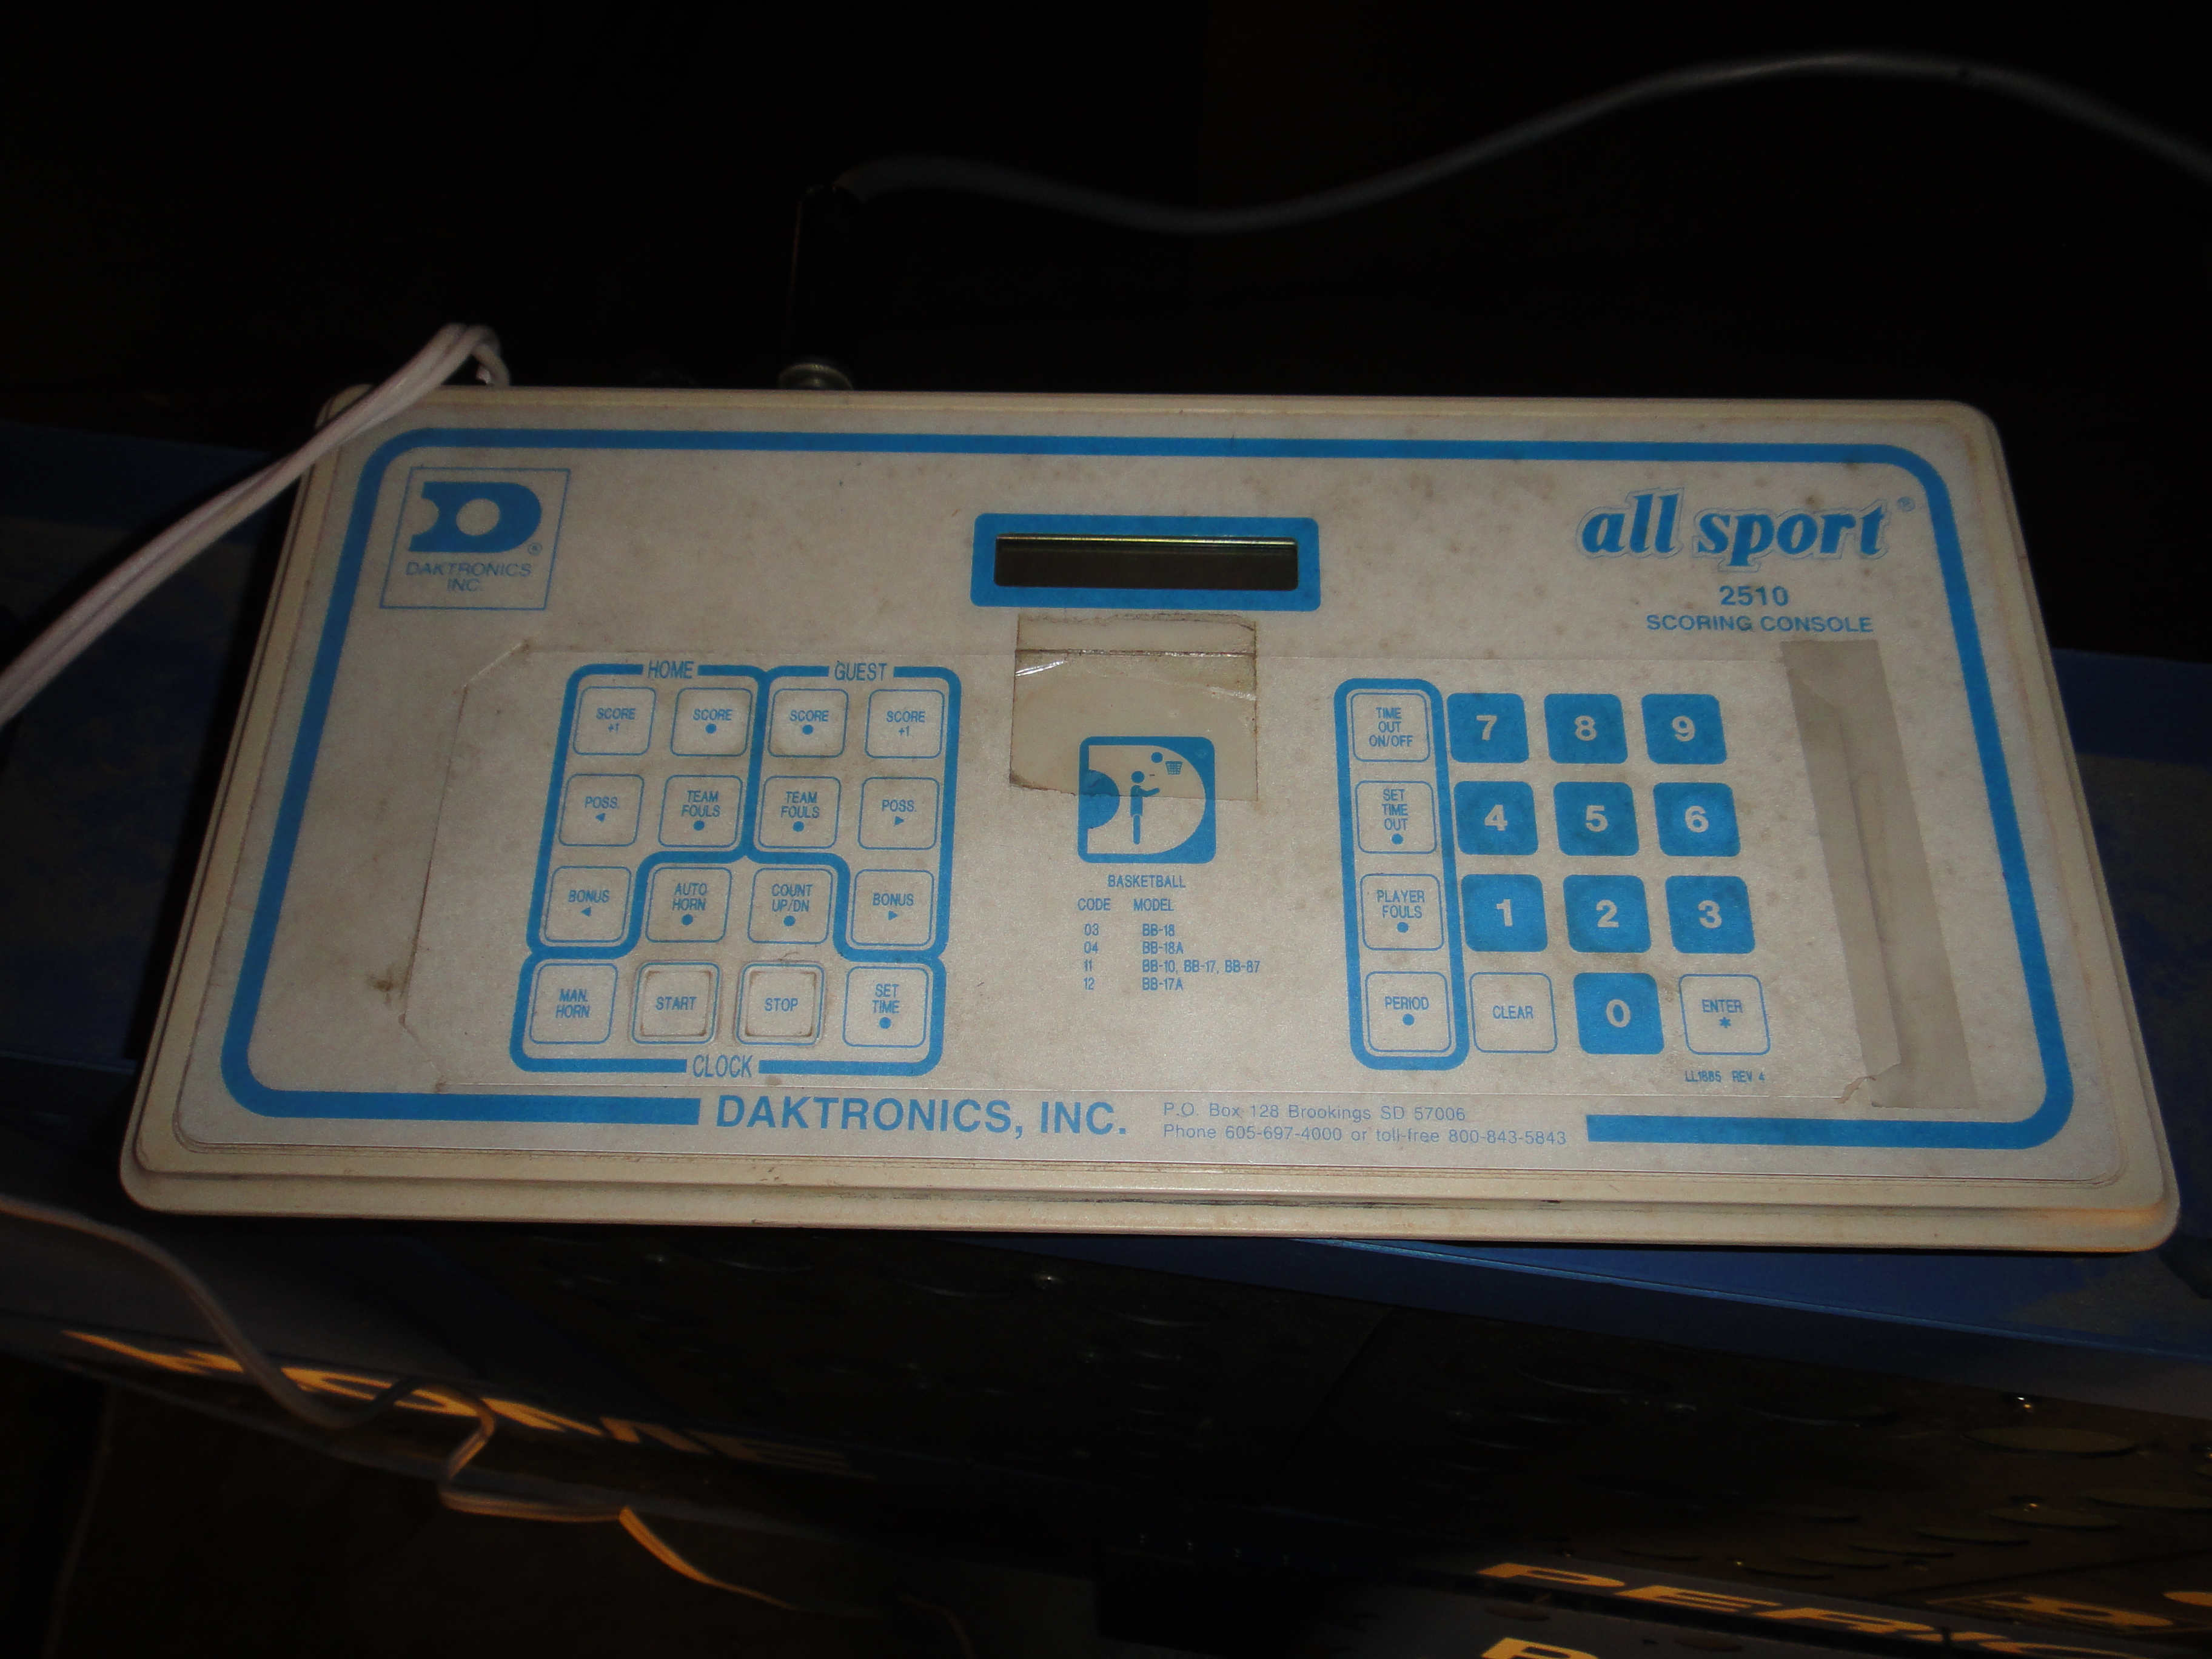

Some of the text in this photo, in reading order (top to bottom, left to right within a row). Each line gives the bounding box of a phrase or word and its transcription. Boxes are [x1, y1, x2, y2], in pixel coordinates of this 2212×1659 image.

[1582, 494, 1883, 566] all sport
[406, 562, 531, 577] DAKTRONICS
[1720, 586, 1789, 606] 2510
[1646, 614, 1872, 632] SCORING CONSOLE
[648, 661, 694, 679] HOME
[834, 662, 887, 681] GUEST
[597, 708, 635, 720] SCORE
[693, 709, 732, 721] SCORE
[790, 710, 829, 722] SCORE
[886, 711, 925, 723] SCORE
[1377, 707, 1400, 719] TIME
[1378, 720, 1401, 733] OUT
[1475, 714, 1498, 741] 7
[1574, 715, 1598, 742] 8
[1671, 715, 1696, 742] 9
[1369, 735, 1413, 747] ON/OFF
[688, 790, 719, 803] TEAM
[786, 791, 817, 803] TEAM
[1383, 788, 1405, 802] SET
[585, 796, 618, 809] POSS.
[882, 799, 916, 813] POSS.
[1382, 803, 1408, 816] TIME
[681, 804, 720, 818] FOULS
[780, 805, 819, 819] FOULS
[1484, 804, 1508, 832] 4
[1384, 817, 1408, 831] OUT
[1584, 804, 1609, 833] 5
[1684, 805, 1709, 834] 6
[1108, 874, 1185, 888] BASKETBALL
[674, 882, 706, 896] AUTO
[772, 883, 813, 897] COUNT
[569, 890, 609, 903] BONUS
[873, 893, 913, 906] BONUS
[1377, 890, 1425, 903] PLAYER
[672, 898, 706, 910] HORN
[773, 899, 809, 912] UP/DN
[1078, 897, 1173, 911] CODE MODEL
[1382, 905, 1423, 919] FOULS
[1495, 899, 1513, 927] 1
[1595, 899, 1620, 928] 2
[1697, 899, 1723, 930] 3
[1084, 923, 1175, 937] 03 BB-18
[1083, 941, 1184, 954] 04 BB-18A
[1083, 959, 1260, 974] 11 BB-10, BB-17, BB-87
[876, 984, 899, 997] SET
[1083, 977, 1183, 991] 12 BB-17A
[656, 996, 696, 1010] START
[765, 997, 798, 1012] STOP
[873, 1000, 899, 1013] TIME
[1384, 996, 1429, 1010] PERIOD
[1702, 999, 1741, 1013] ENTER
[556, 1004, 589, 1018] HORN
[1493, 1005, 1533, 1019] CLEAR
[1605, 998, 1632, 1028] 0
[692, 1054, 751, 1078] CLOCK
[1732, 1070, 1752, 1083] REV
[716, 1094, 1125, 1139] DAKTRONICS, INC.
[1163, 1102, 1466, 1124] P.O. Box 128 Brookings SD 57006
[1163, 1124, 1567, 1145] Phone 605-697-4000 or toll-free 800-843-5843
